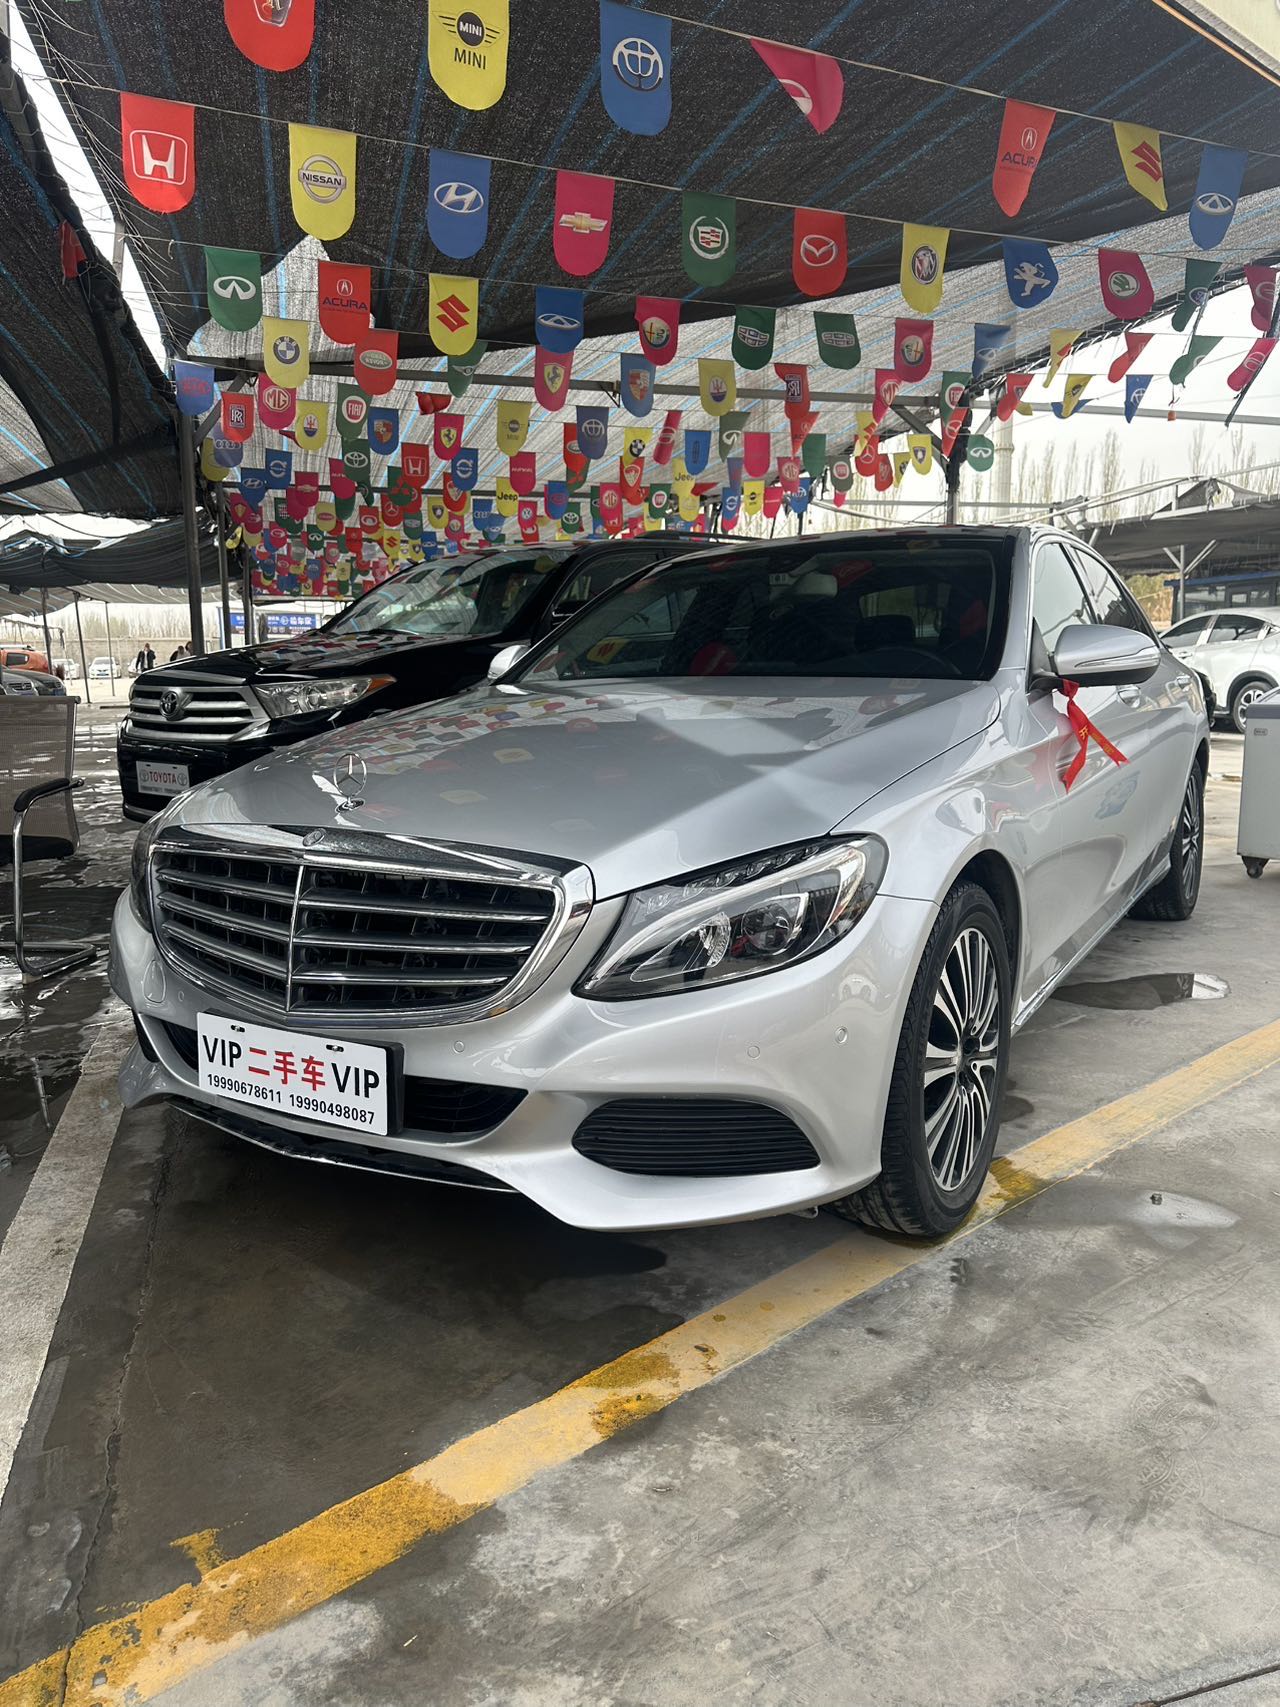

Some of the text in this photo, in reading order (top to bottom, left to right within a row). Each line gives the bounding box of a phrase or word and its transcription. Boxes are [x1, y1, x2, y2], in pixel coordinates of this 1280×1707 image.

[459, 21, 483, 37] MINI
[454, 47, 486, 70] MINI
[1001, 151, 1038, 169] ACUR
[302, 172, 342, 186] NISSAN
[322, 296, 368, 310] ACURA
[266, 389, 288, 410] MG
[348, 402, 362, 416] FIAT
[497, 492, 518, 502] Jeep
[149, 770, 177, 785] TOYOTA
[202, 1034, 380, 1099] VIP 二手车 VIP
[207, 1073, 375, 1125] 19990678611 19990498087
